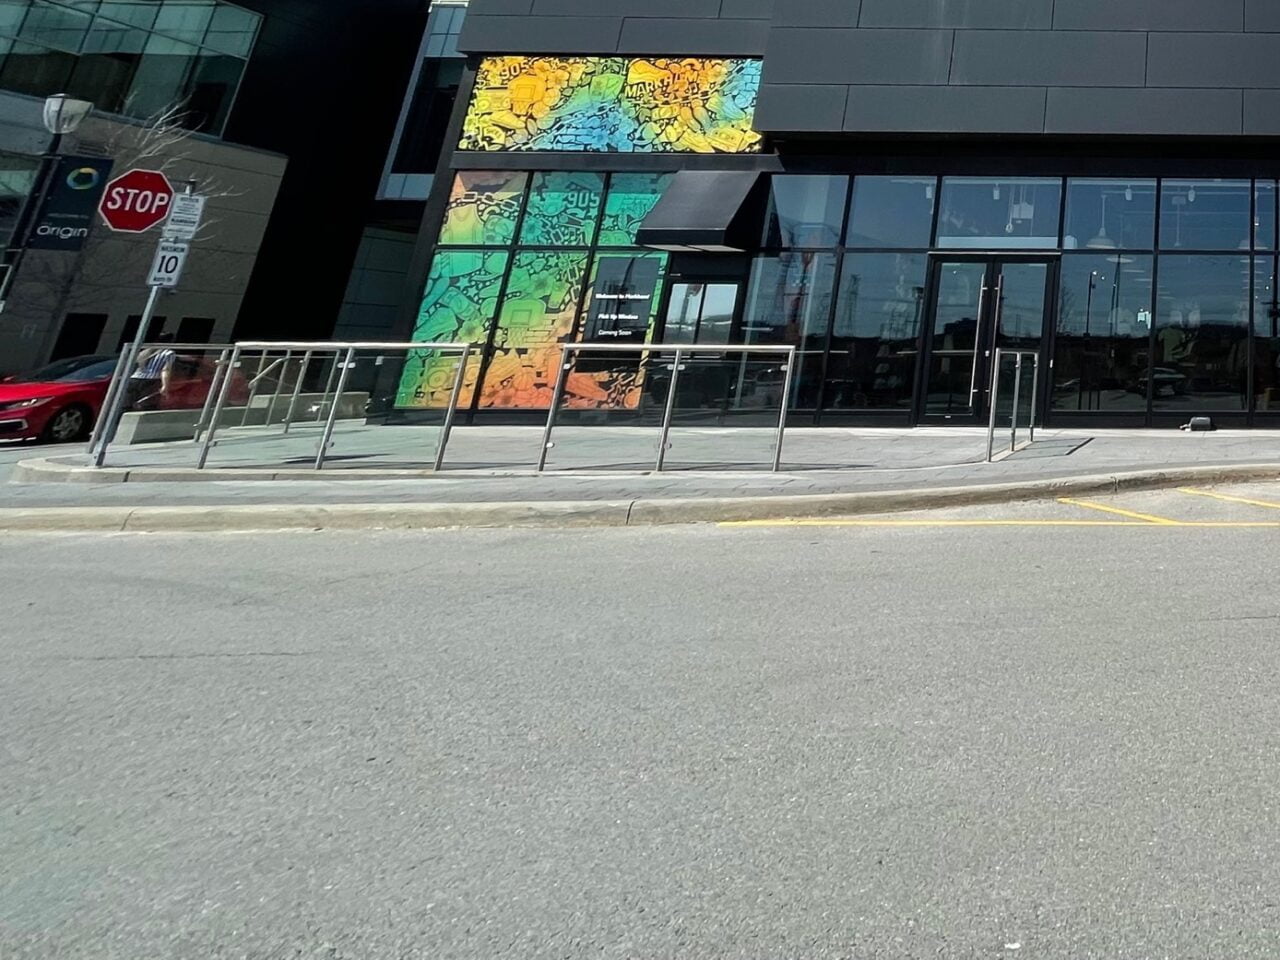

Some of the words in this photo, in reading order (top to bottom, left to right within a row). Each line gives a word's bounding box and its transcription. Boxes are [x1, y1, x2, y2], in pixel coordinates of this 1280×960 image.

[499, 60, 529, 80] 905
[106, 187, 169, 214] STOP
[566, 190, 601, 208] 905
[36, 225, 88, 240] Origin
[157, 255, 179, 274] 10
